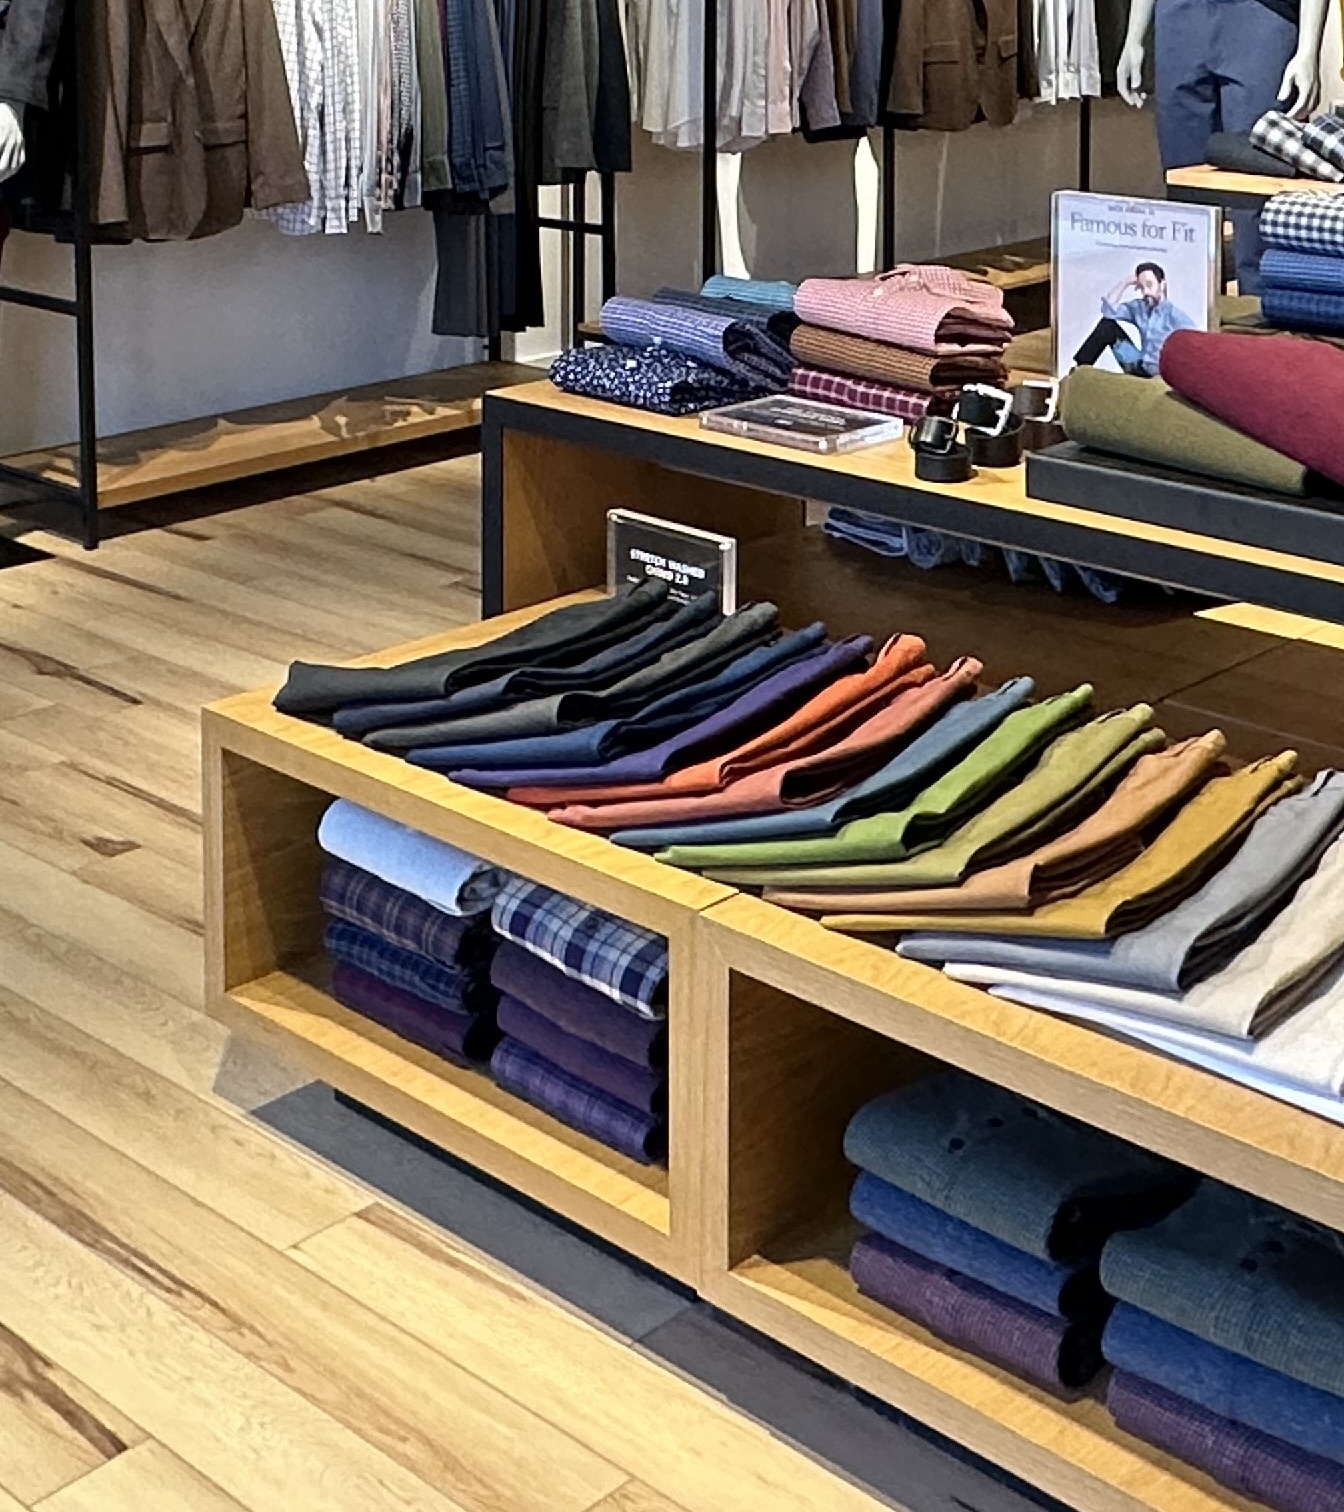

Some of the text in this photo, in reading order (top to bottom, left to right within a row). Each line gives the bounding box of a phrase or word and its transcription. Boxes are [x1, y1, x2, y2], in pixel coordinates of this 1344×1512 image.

[1070, 211, 1196, 243] Famous for Fit
